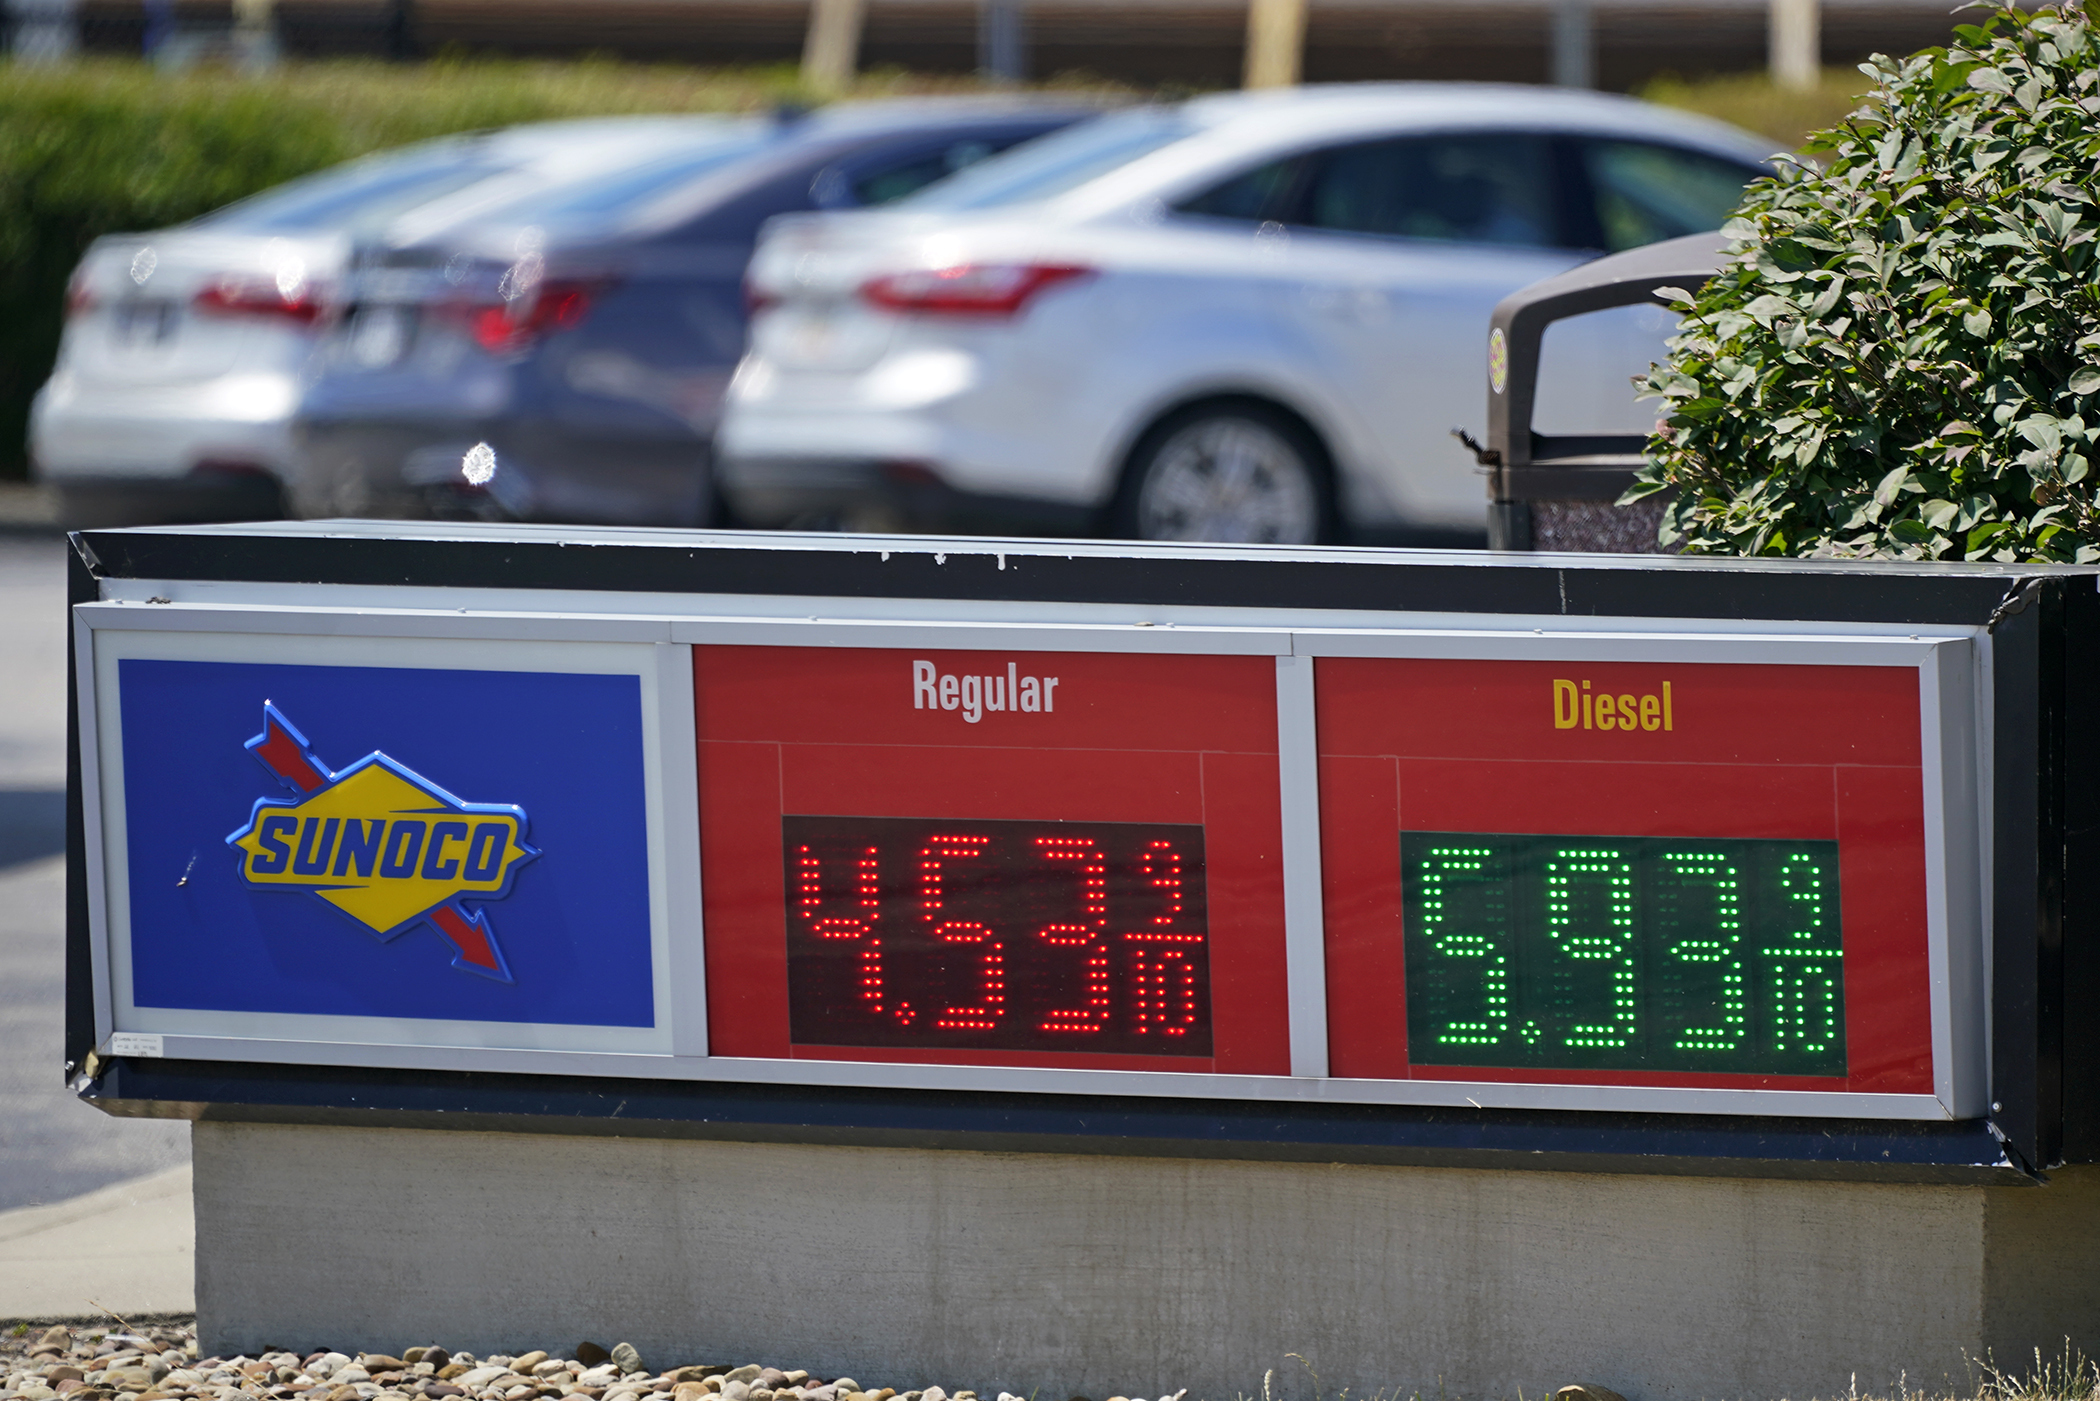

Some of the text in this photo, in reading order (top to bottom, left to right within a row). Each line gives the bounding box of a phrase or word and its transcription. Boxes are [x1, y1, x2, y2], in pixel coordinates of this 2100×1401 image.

[912, 659, 1059, 723] Regular
[1553, 679, 1673, 731] Diesel
[251, 815, 511, 882] SUNOCO
[800, 835, 1109, 1032] 4.53
[1422, 848, 1745, 1051] 5.93
